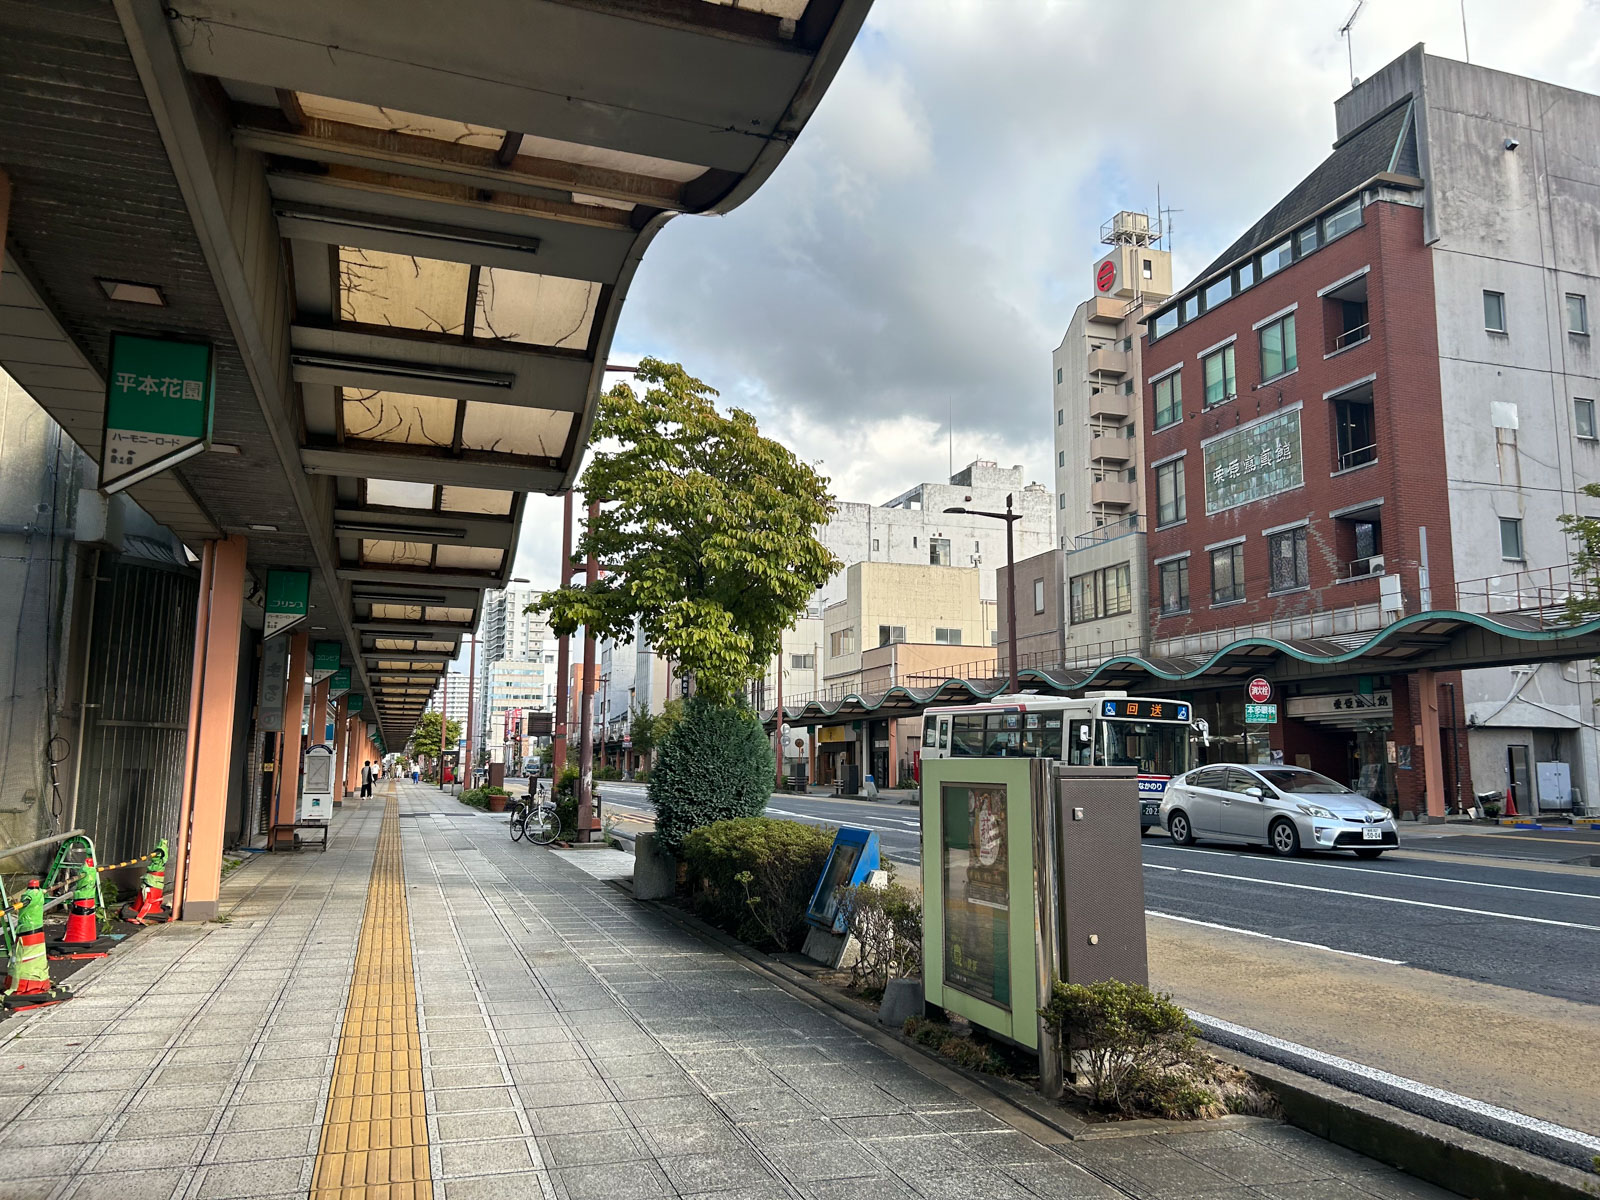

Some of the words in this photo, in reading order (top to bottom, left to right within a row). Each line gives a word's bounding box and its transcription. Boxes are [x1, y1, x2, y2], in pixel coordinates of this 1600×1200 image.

[115, 372, 203, 401] 平本花園
[112, 433, 180, 446] ハーモニーロード
[1251, 686, 1269, 695] 消火栓
[1126, 702, 1163, 717] 回送
